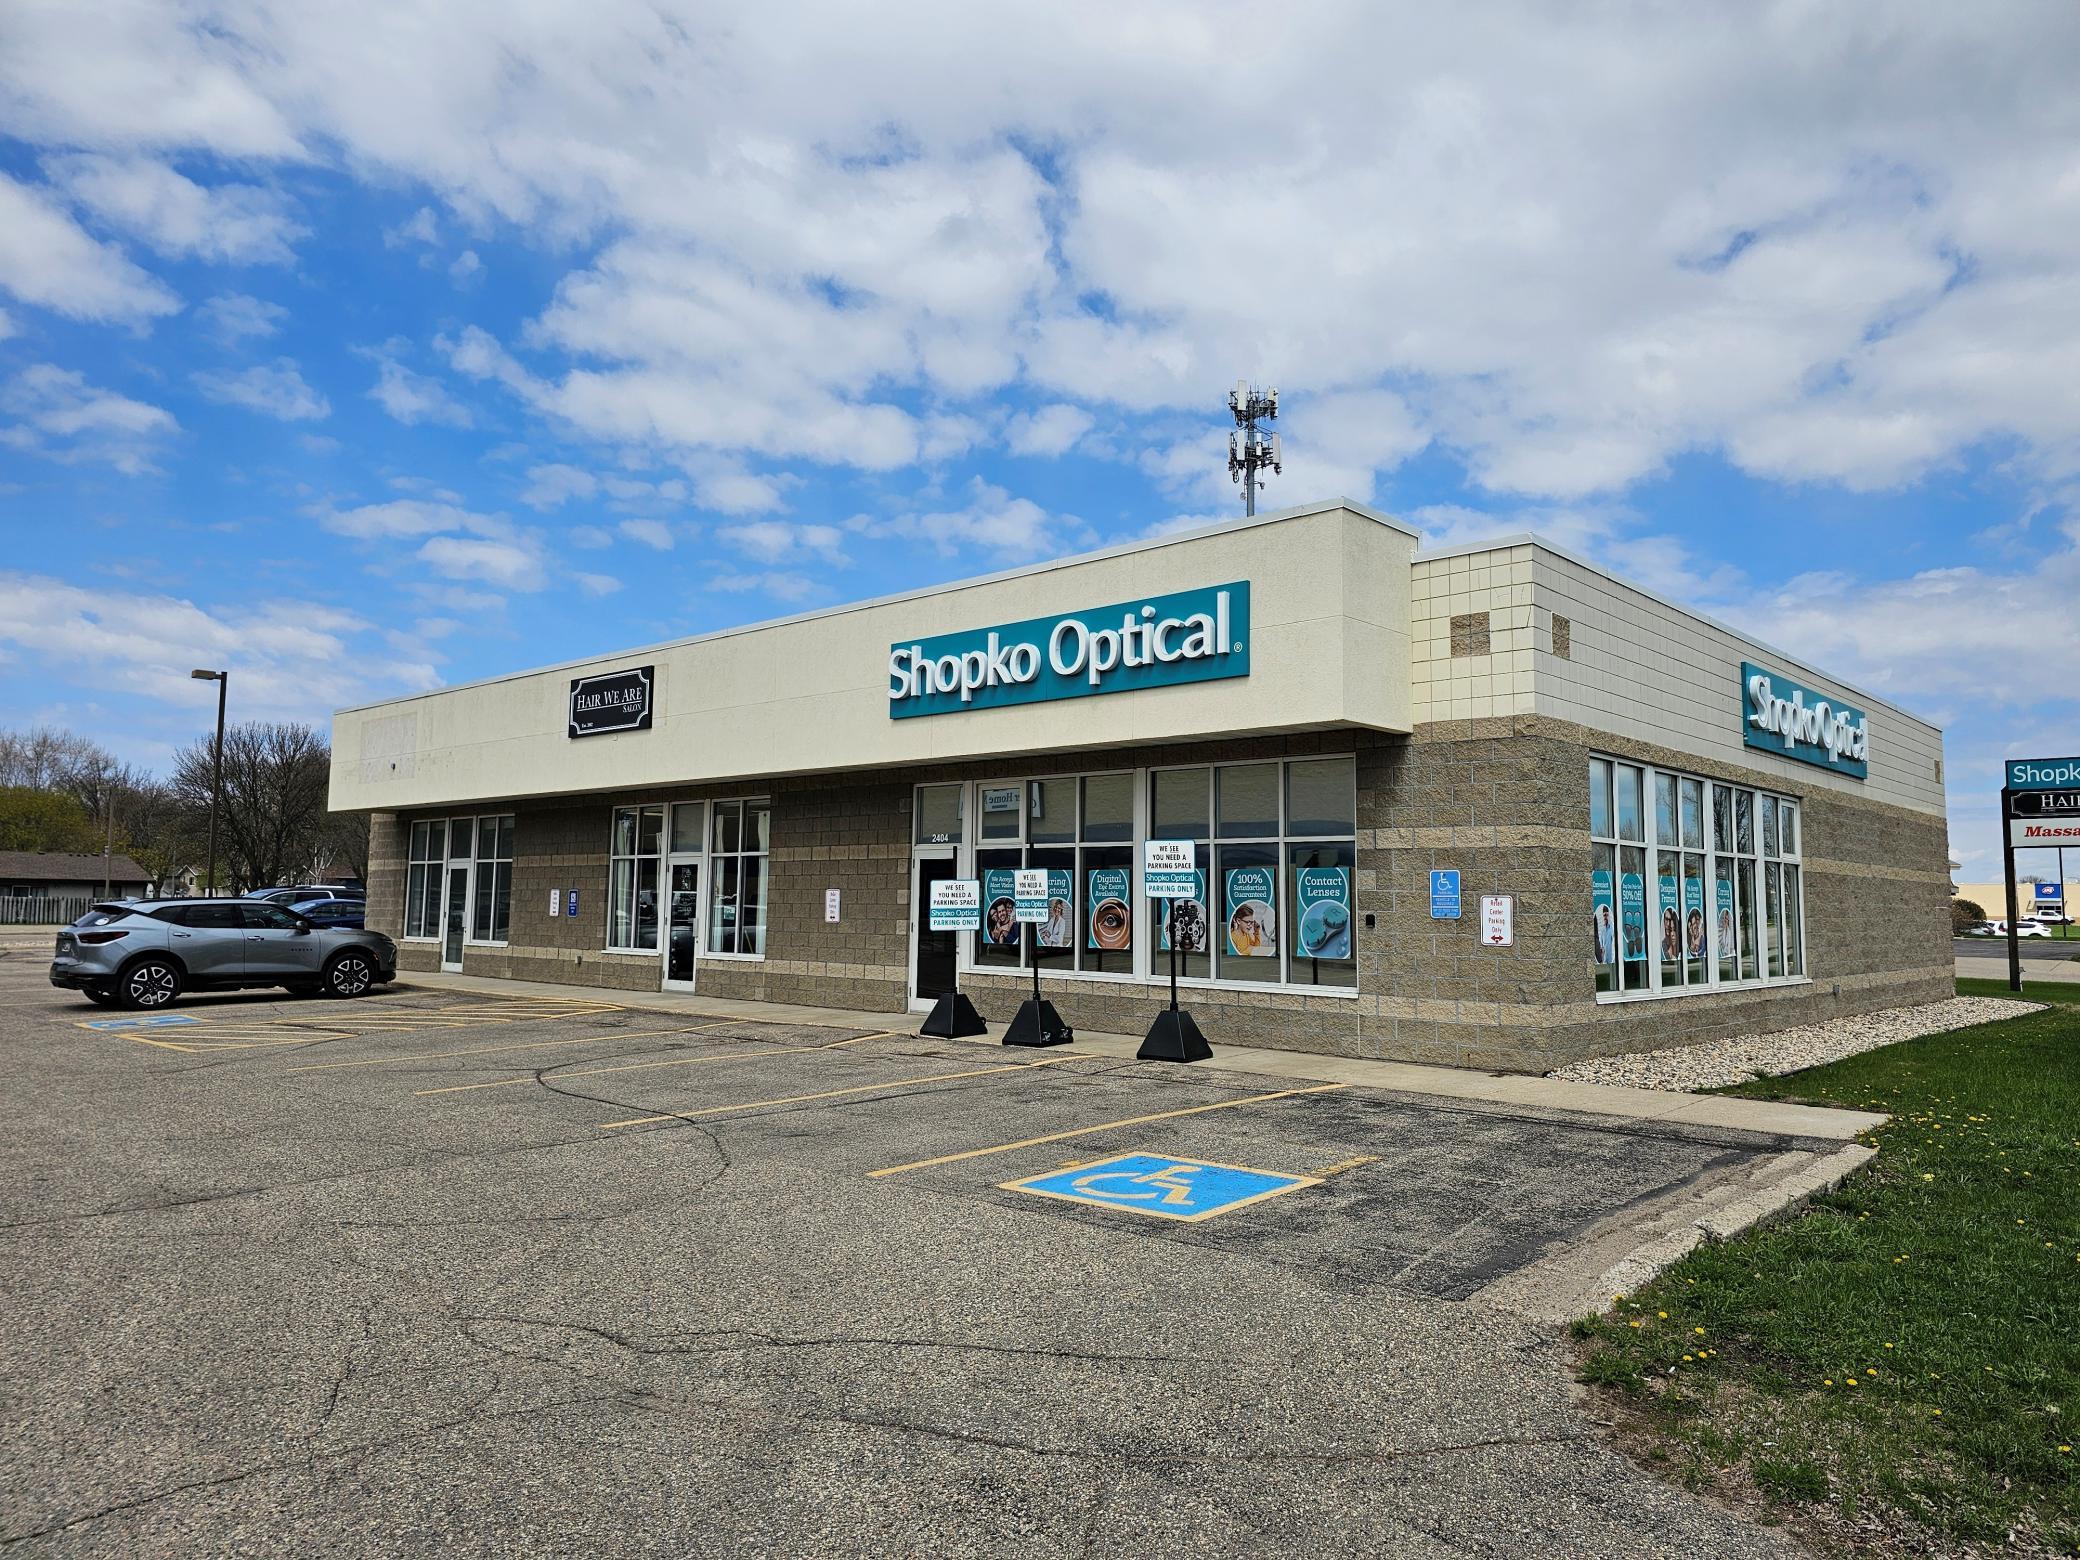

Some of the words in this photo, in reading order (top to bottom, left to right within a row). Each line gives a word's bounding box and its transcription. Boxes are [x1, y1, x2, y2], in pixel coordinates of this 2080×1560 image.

[889, 632, 1041, 701] Shopko
[1050, 591, 1230, 685] Optical
[577, 694, 601, 709] HAIR
[604, 690, 620, 704] WE
[622, 687, 642, 702] ARE
[623, 703, 642, 712] SALON
[1747, 675, 1818, 748] Shopko
[2024, 826, 2080, 838] Massa
[932, 833, 949, 843] 2404
[1048, 876, 1067, 888] ring
[1096, 874, 1122, 885] Digital
[1146, 874, 1170, 883] Shopko
[1171, 873, 1194, 883] Optical
[1237, 873, 1263, 884] 100%
[1304, 876, 1343, 886] Contact
[1306, 887, 1341, 897] Lenses
[1030, 900, 1048, 908] Optical
[931, 909, 955, 918] Shopko
[955, 909, 979, 918] Optical
[1333, 909, 1342, 917] R
[1307, 924, 1318, 934] L
